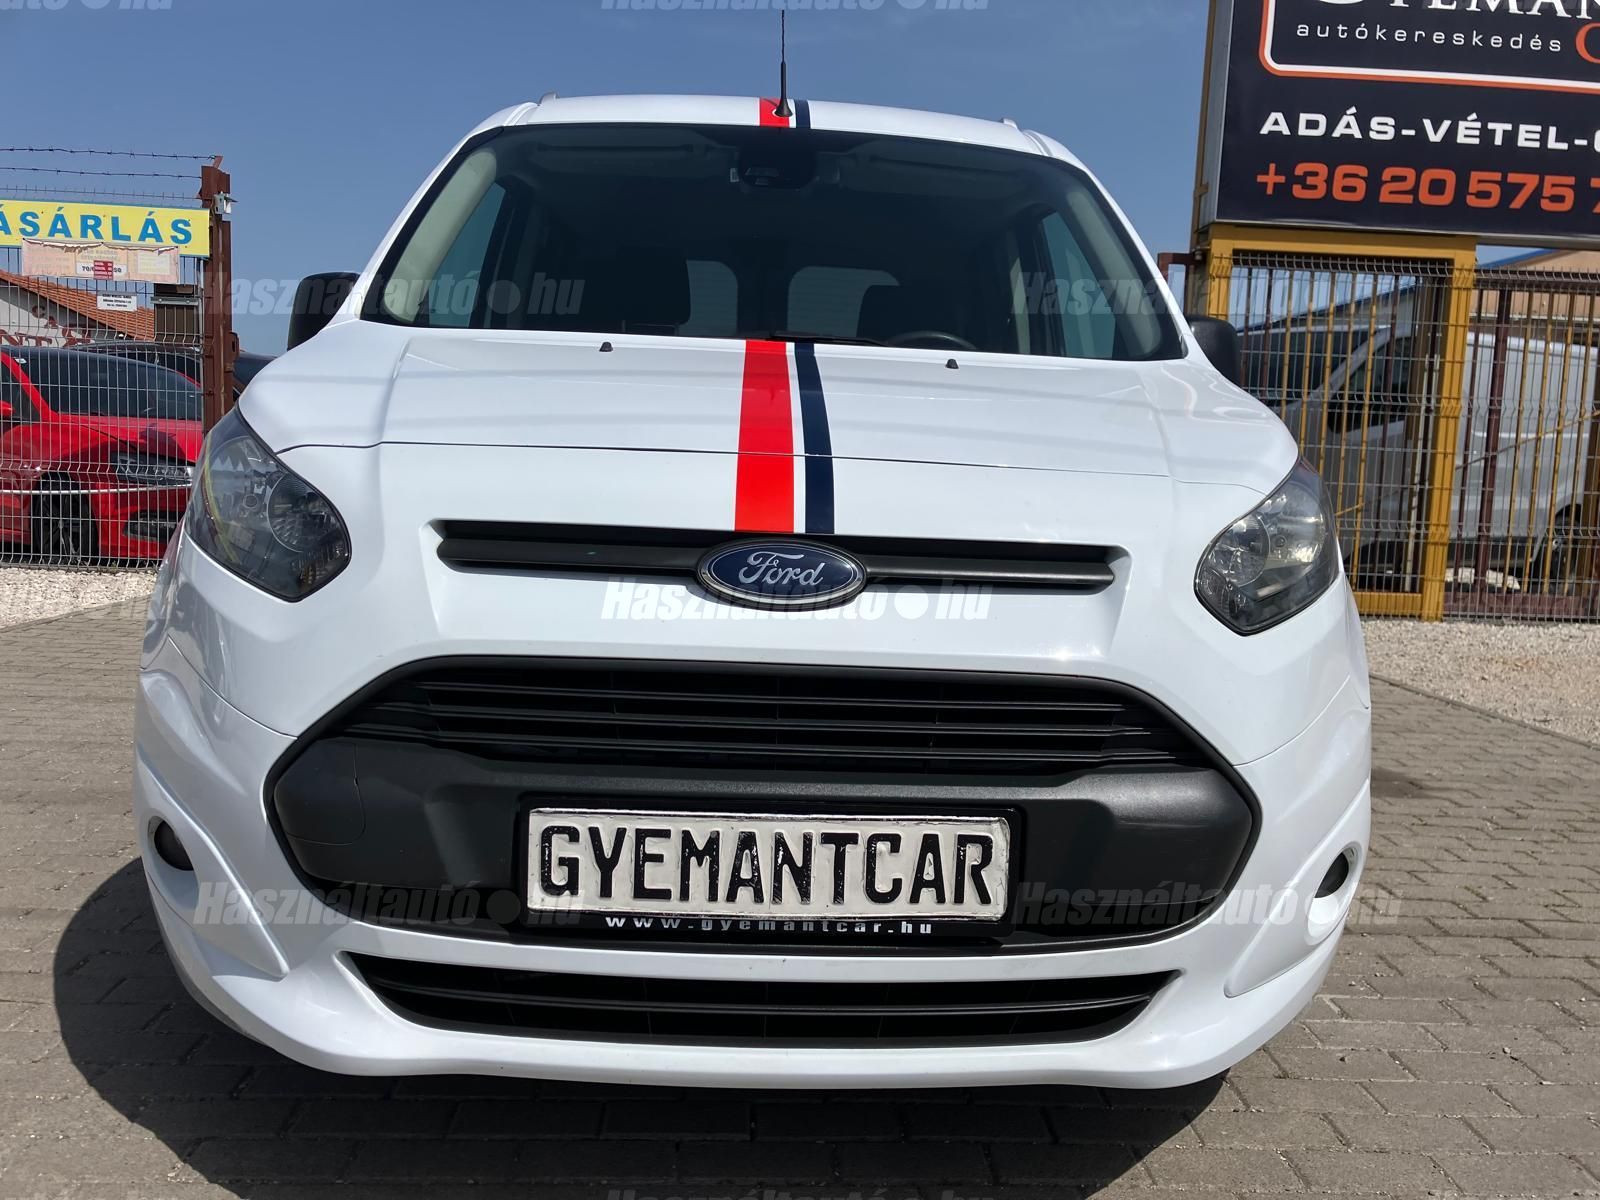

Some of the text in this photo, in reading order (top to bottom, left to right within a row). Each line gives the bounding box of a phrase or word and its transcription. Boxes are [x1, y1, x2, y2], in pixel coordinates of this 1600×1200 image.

[1296, 22, 1562, 52] autókereskedés
[1259, 106, 1600, 152] ADÁS-VÉTEL-
[1256, 162, 1369, 202] +36
[1379, 167, 1457, 206] 20
[1466, 171, 1576, 213] 575
[738, 551, 825, 587] Ford
[540, 824, 994, 905] GYEMANTCAR
[605, 916, 933, 934] www.gyemantcar.hu
